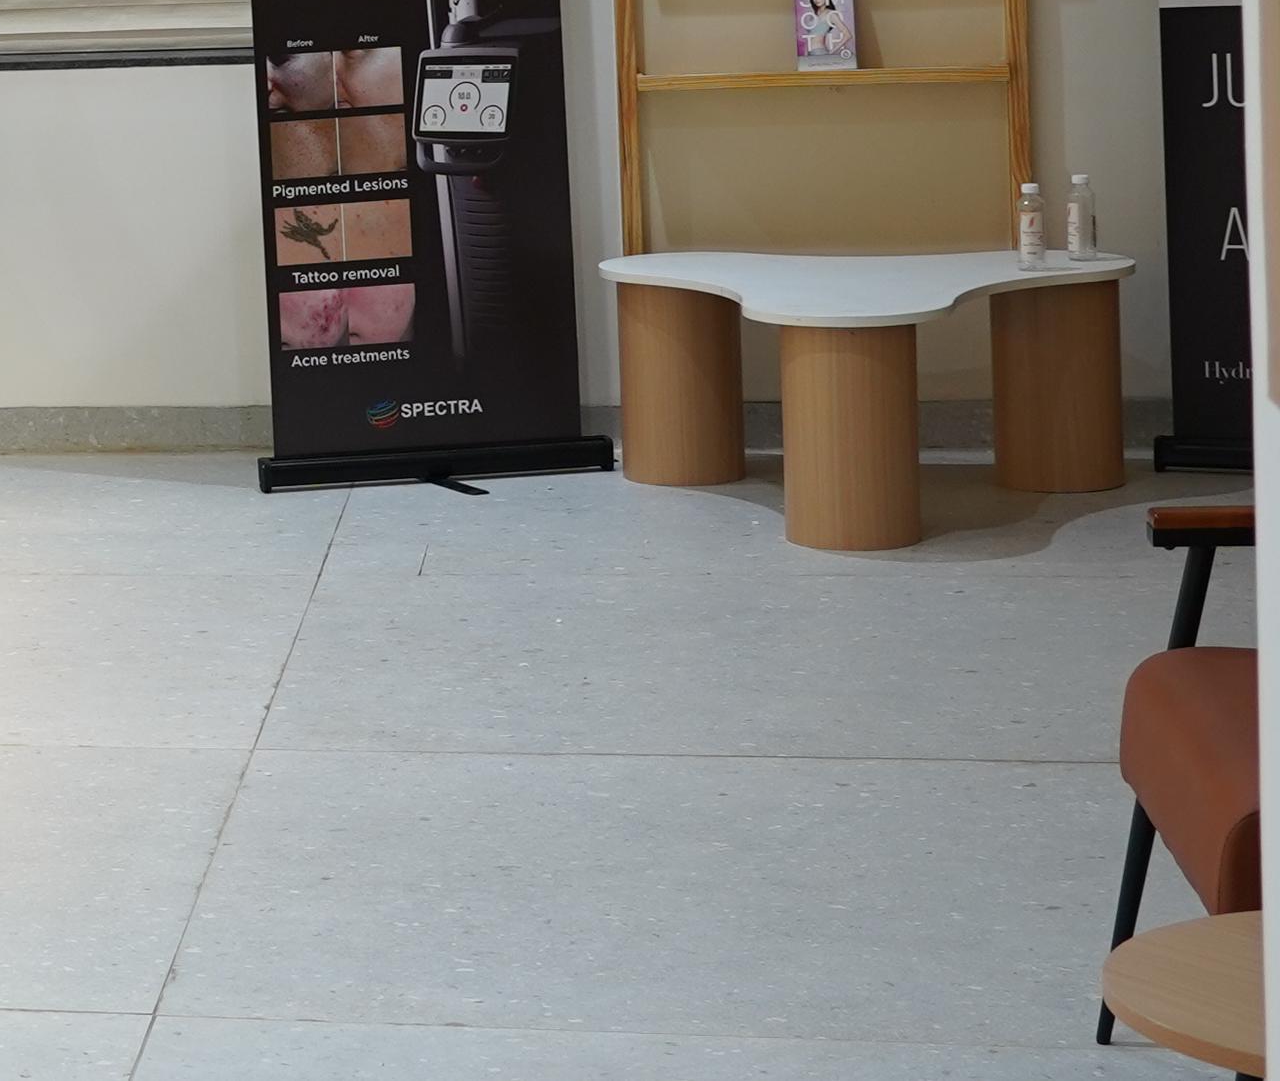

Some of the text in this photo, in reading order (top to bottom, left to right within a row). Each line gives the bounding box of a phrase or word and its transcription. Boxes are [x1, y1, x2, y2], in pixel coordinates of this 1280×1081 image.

[287, 35, 379, 48] Before After
[272, 177, 409, 199] Pigmented Lesions
[292, 264, 400, 285] Tattoo removal
[291, 348, 410, 368] Acne treatments
[400, 399, 483, 419] SPECTRA
